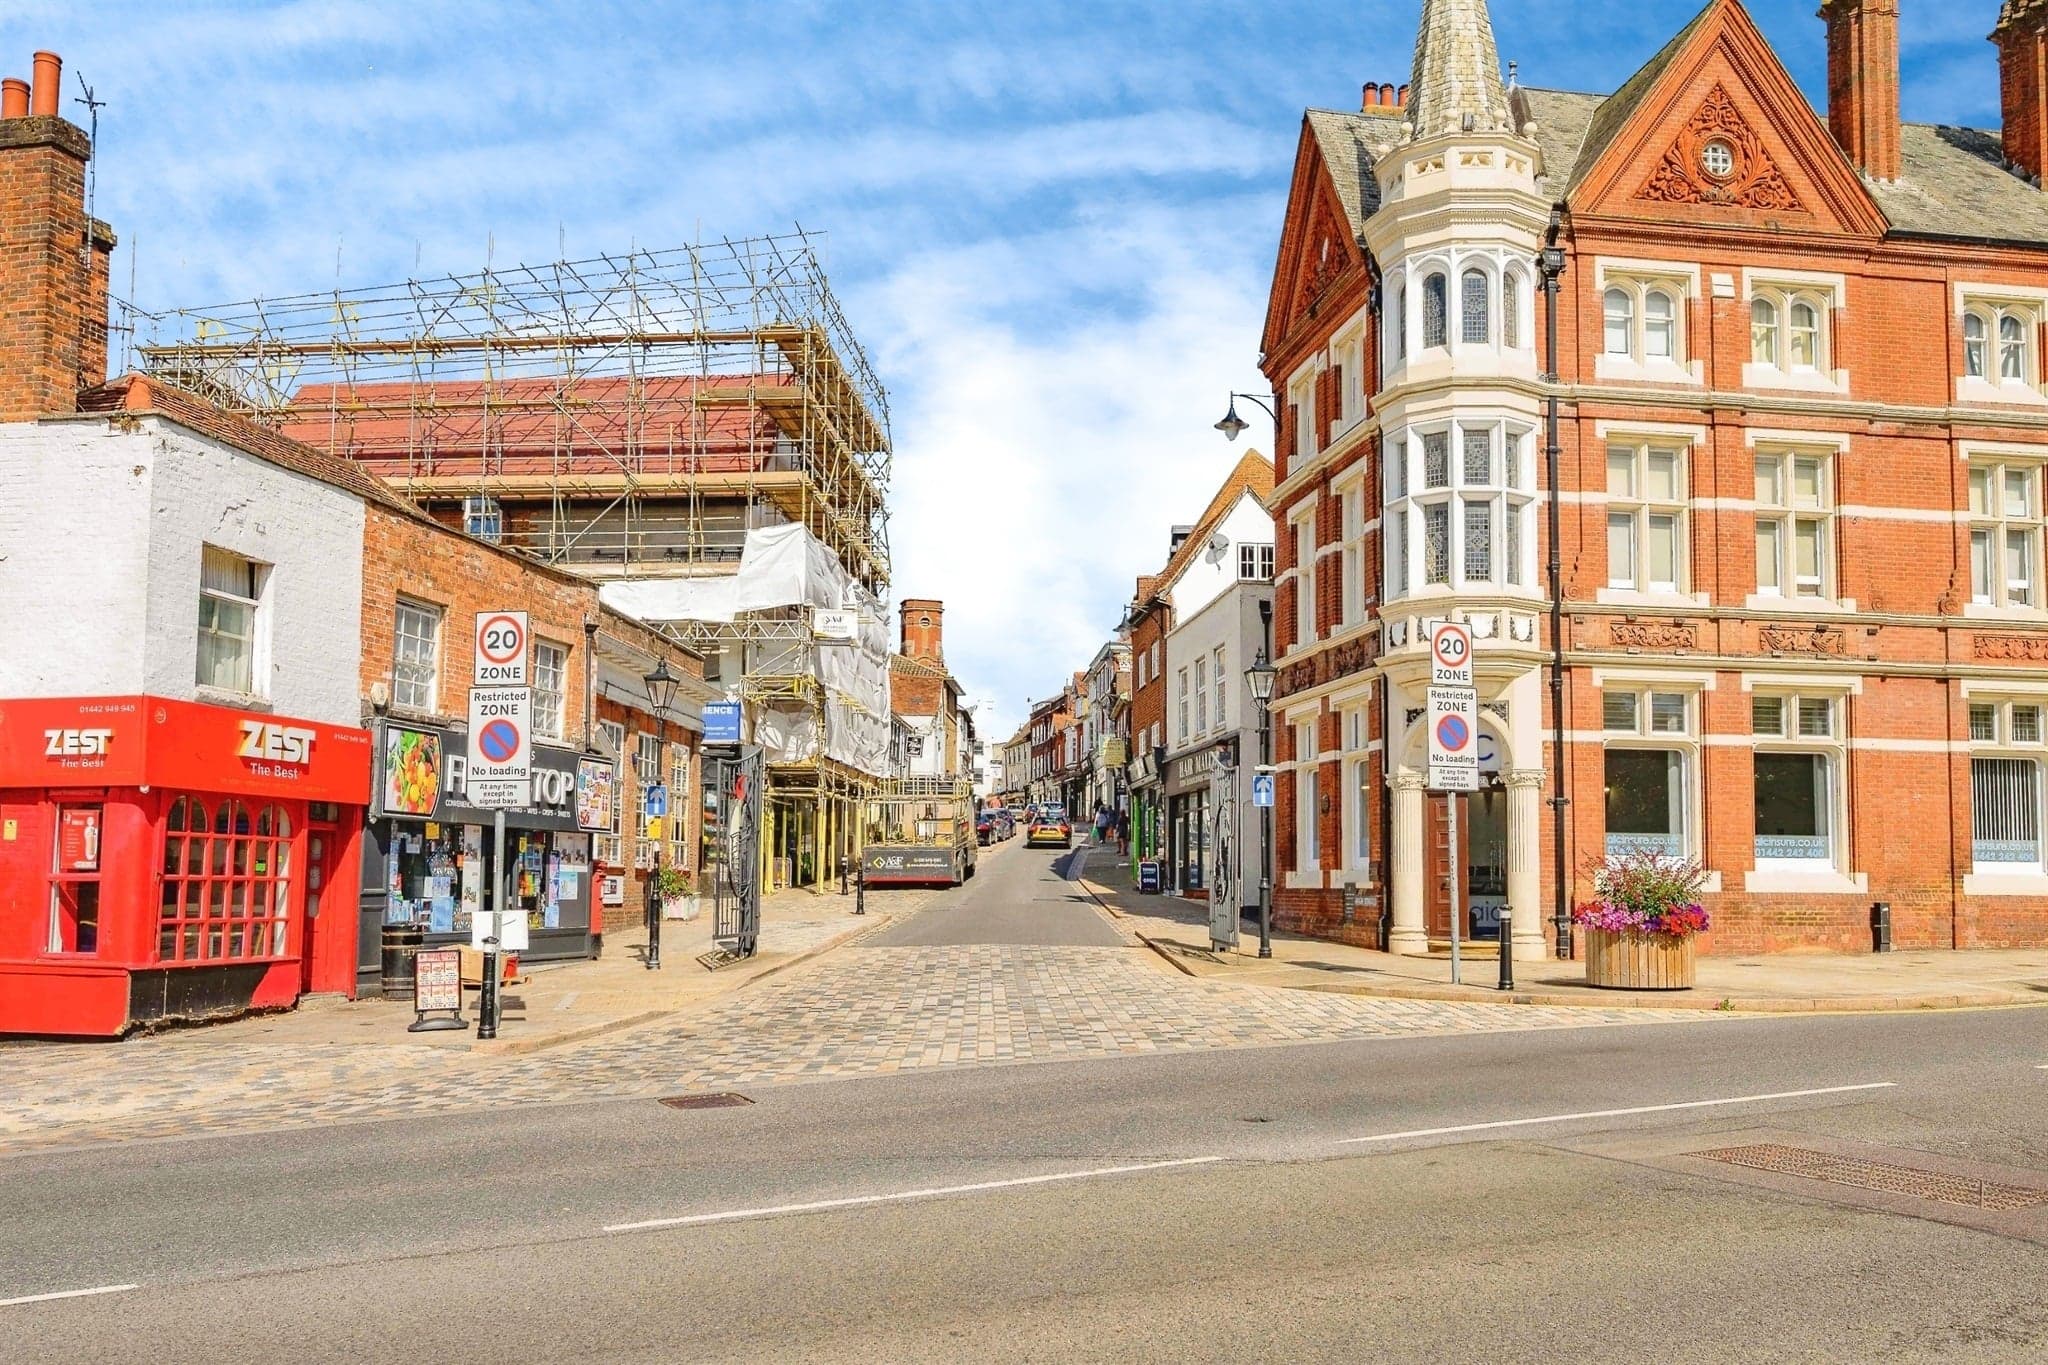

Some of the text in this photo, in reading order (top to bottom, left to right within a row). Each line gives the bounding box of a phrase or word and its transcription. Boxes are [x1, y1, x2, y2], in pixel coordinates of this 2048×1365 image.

[487, 630, 517, 649] 20
[1441, 638, 1464, 655] 20
[480, 667, 521, 679] ZONE
[1437, 669, 1468, 680] ZONE
[474, 691, 527, 702] Restricted
[1431, 690, 1473, 700] Restricted
[480, 703, 519, 716] ZONE
[1437, 701, 1467, 712] ZONE
[44, 728, 112, 756] ZEST
[241, 719, 316, 765] ZEST
[61, 759, 104, 768] The Best
[1432, 754, 1475, 765] No loading
[251, 762, 299, 780] The Best
[472, 766, 527, 777] No loading
[489, 784, 500, 792] any
[531, 767, 575, 806] TOP
[1755, 848, 1825, 857] 01442 242 400
[885, 855, 904, 866] A&F
